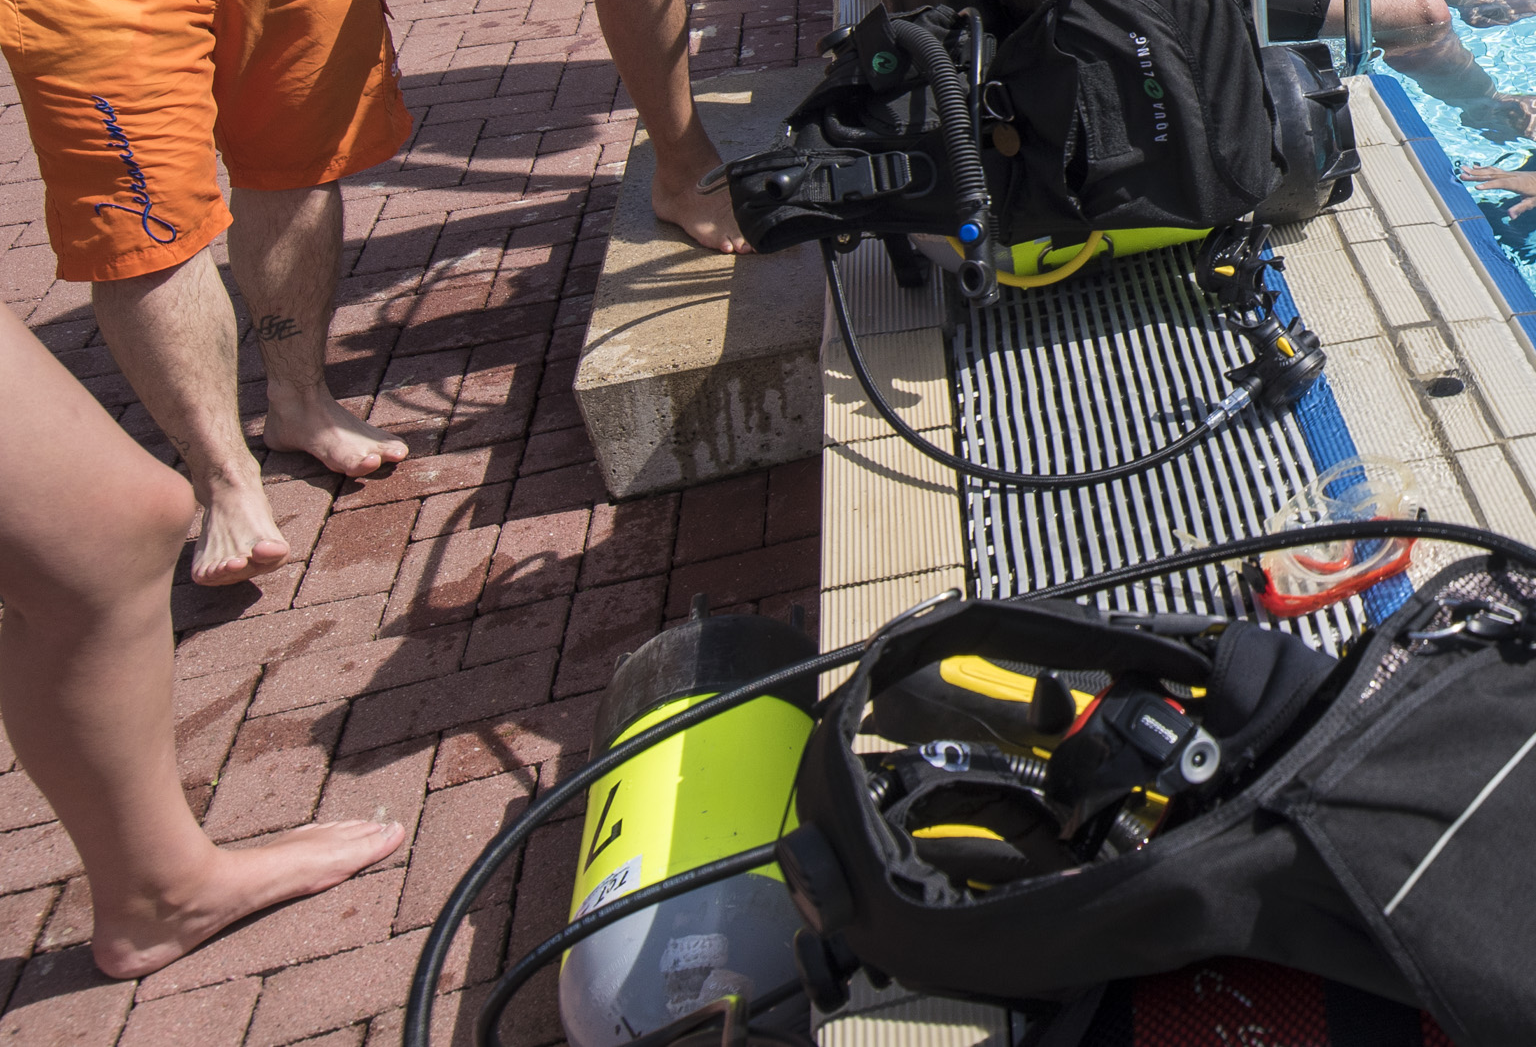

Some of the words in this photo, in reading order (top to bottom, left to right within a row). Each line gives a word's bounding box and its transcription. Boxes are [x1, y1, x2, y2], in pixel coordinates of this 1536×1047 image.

[1135, 36, 1155, 78] LUNG
[1153, 102, 1169, 142] AQUA
[91, 94, 177, 244] Jeronimo
